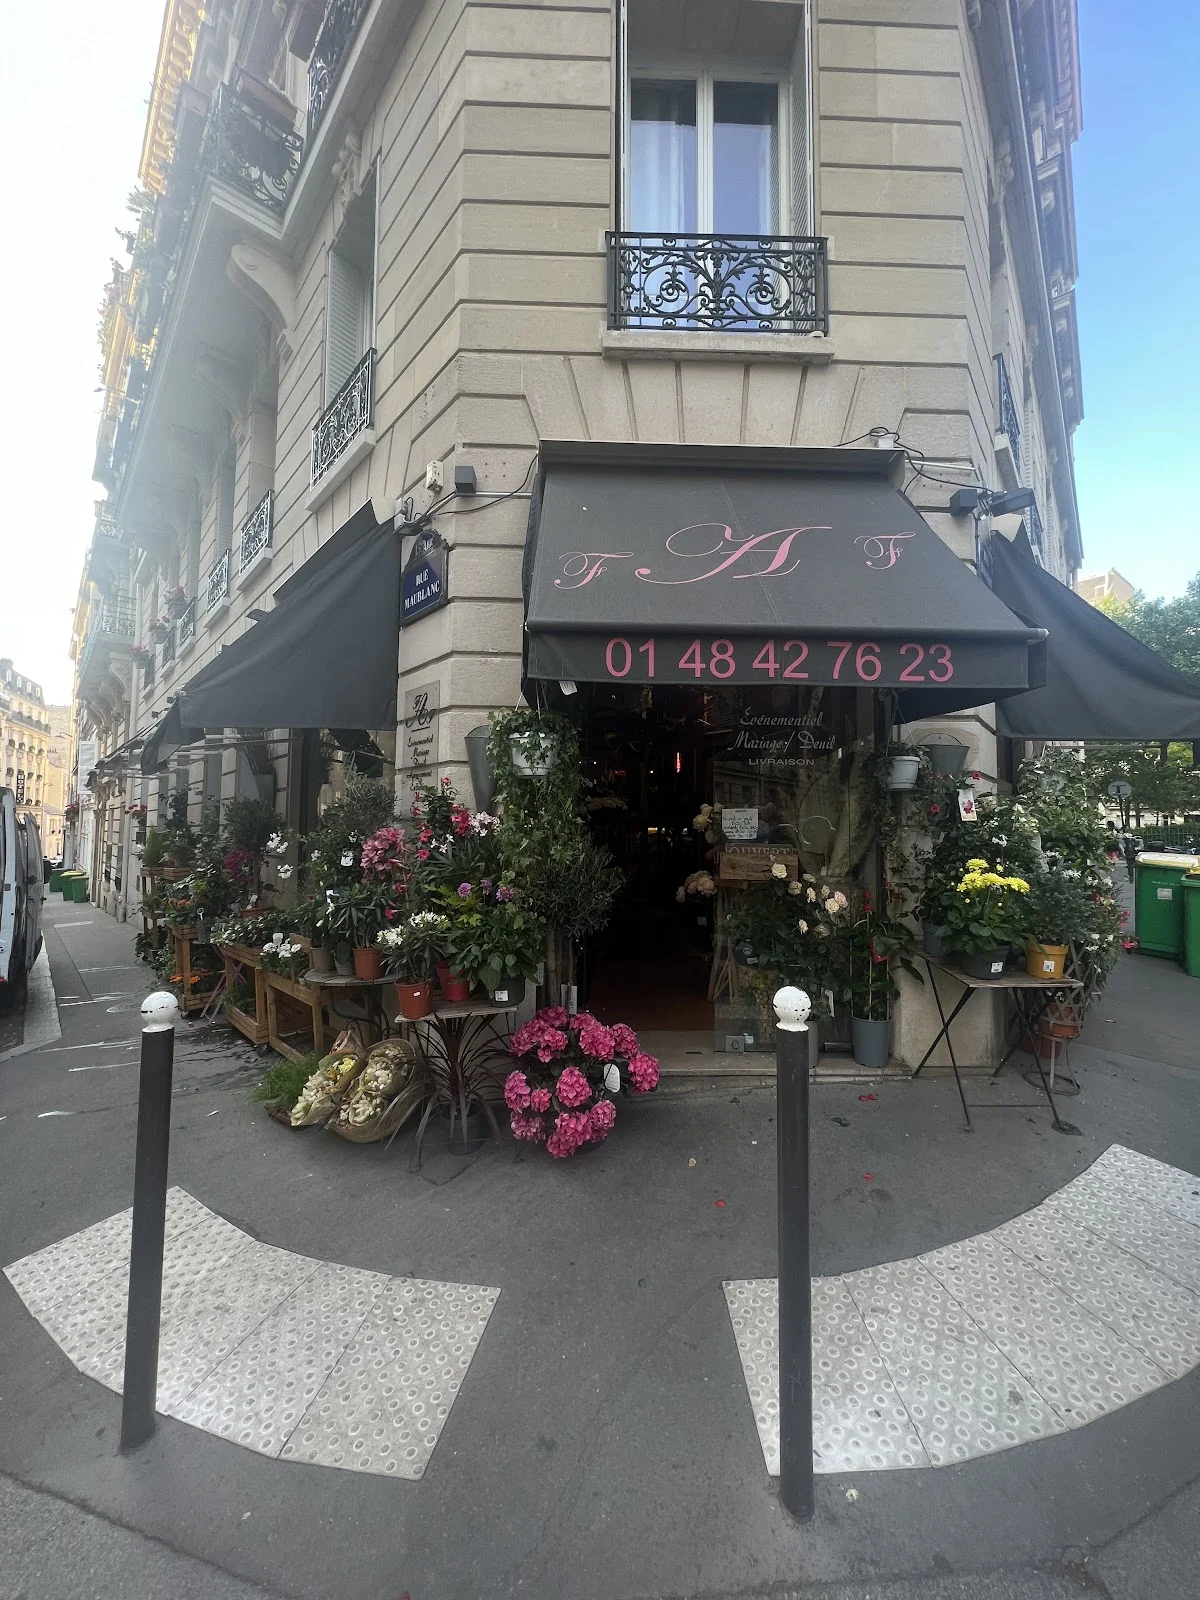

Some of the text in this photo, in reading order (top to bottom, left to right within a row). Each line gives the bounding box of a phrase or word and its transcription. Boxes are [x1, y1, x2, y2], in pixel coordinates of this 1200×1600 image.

[415, 569, 429, 587] RUE
[404, 581, 440, 610] MAUBLANC
[605, 637, 955, 683] 01 48 42 76 23
[797, 730, 836, 750] Deuil
[748, 758, 815, 766] LIVRAISON
